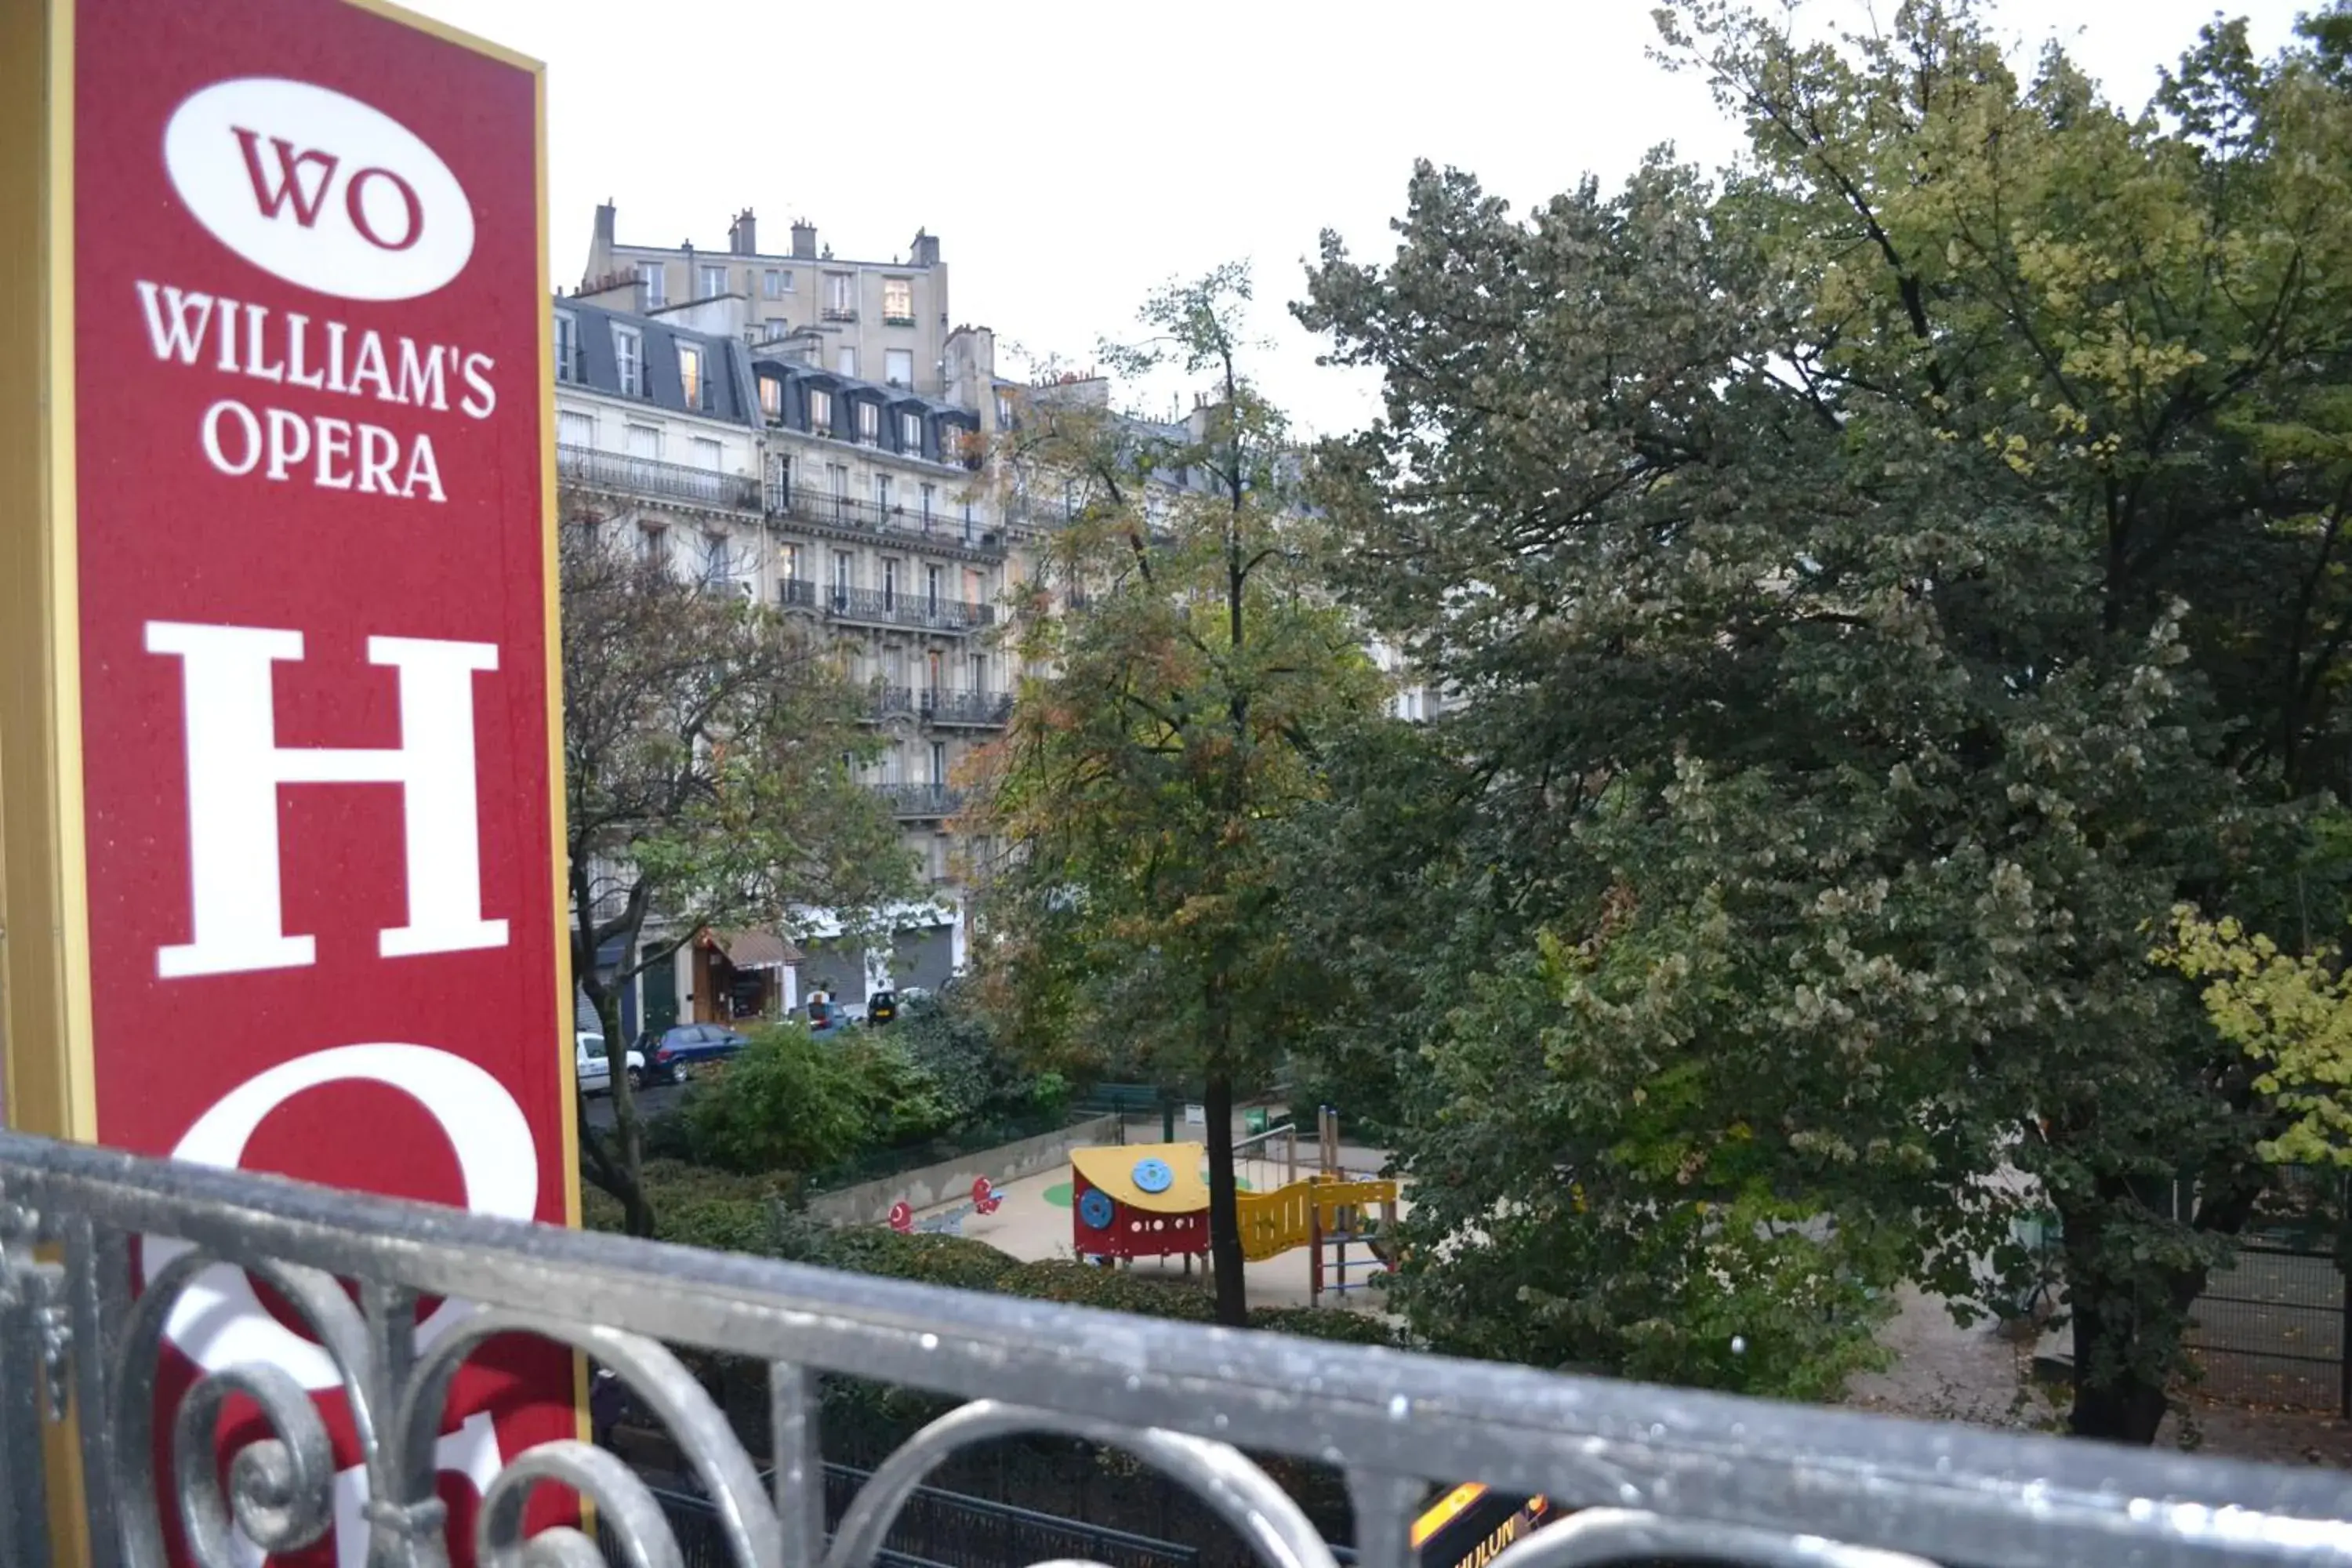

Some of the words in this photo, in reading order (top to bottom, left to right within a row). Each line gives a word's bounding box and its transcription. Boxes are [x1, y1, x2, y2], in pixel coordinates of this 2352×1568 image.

[230, 125, 424, 252] WO
[135, 279, 497, 419] WILLIAM'S
[201, 398, 448, 503] OPERA
